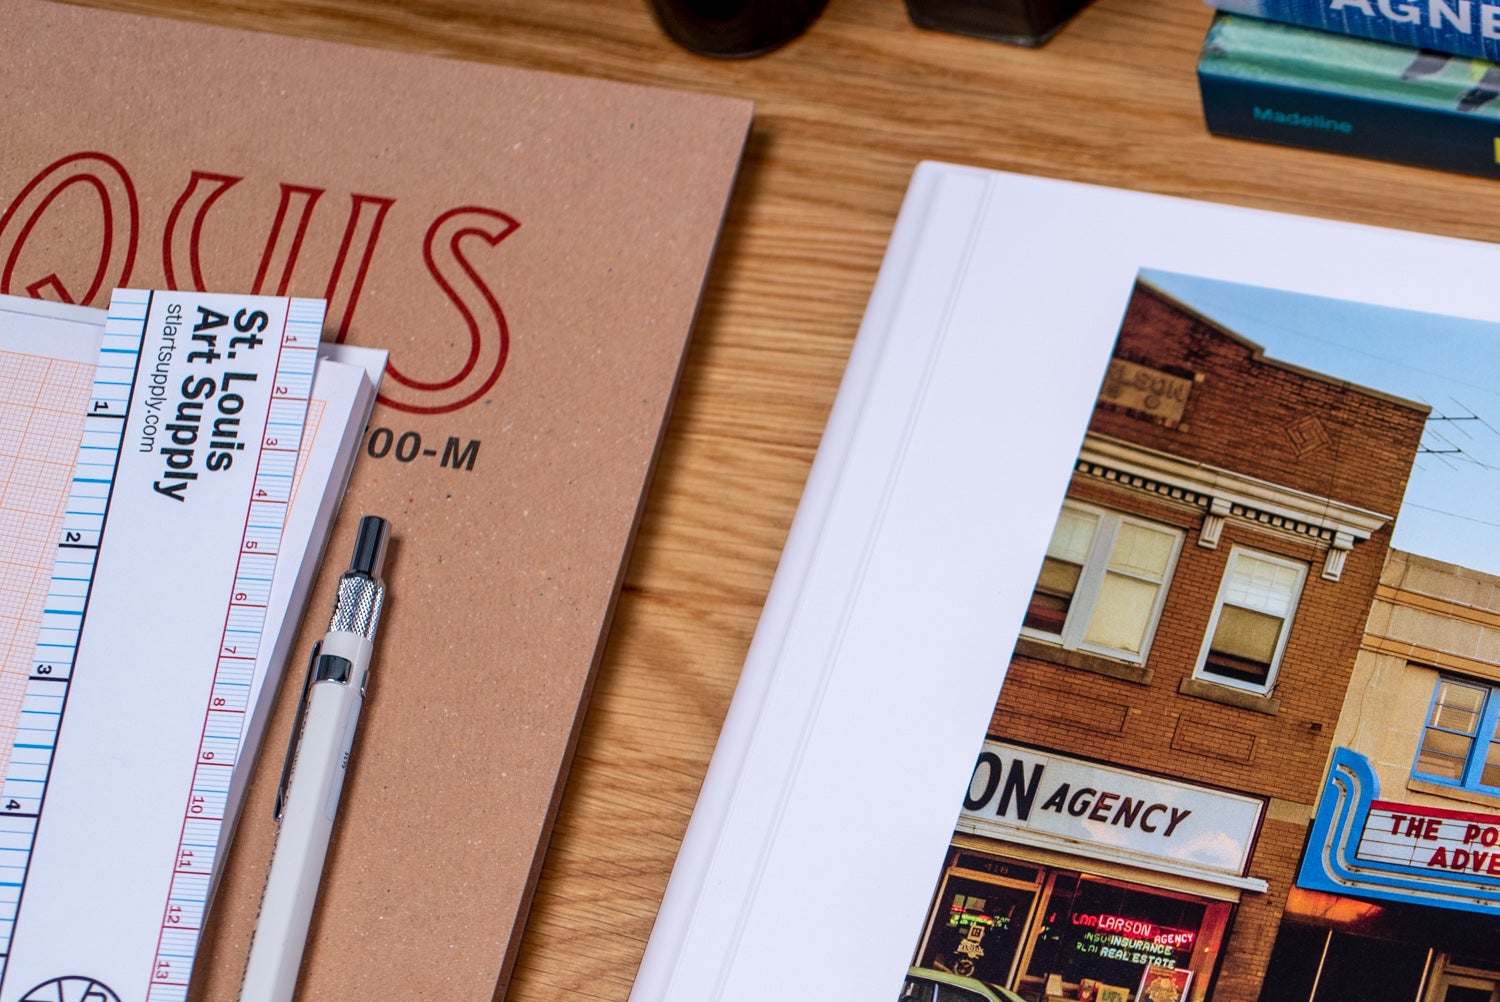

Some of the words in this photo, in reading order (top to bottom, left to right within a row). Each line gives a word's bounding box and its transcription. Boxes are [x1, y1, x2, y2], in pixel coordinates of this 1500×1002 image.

[1252, 105, 1353, 134] Madeline
[187, 305, 229, 364] Art
[227, 307, 269, 360] St.
[285, 335, 297, 344] 1
[139, 303, 182, 453] stlartsupply.com
[276, 386, 288, 395] 2
[94, 401, 109, 412] 1
[206, 371, 258, 472] Louis
[153, 374, 217, 503] Supply
[266, 438, 278, 446] 3
[364, 425, 481, 471] 00-M
[256, 489, 267, 497] 4
[66, 531, 82, 543] 2
[245, 540, 258, 549] 5
[235, 592, 247, 601] 6
[224, 646, 237, 654] 7
[37, 664, 52, 675] 3
[213, 698, 226, 707] 8
[202, 751, 214, 760] 9
[5, 799, 20, 811] 4
[191, 797, 205, 814] 10
[1041, 783, 1192, 838] AGENCY
[1391, 814, 1443, 841] THE
[179, 849, 194, 868] 11
[167, 905, 182, 924] 12
[1098, 914, 1152, 936] LARSON
[1153, 933, 1194, 945] AGENCY
[1110, 935, 1173, 956] INSURANCE
[1100, 946, 1130, 961] REAL
[1132, 954, 1176, 970] ESTATE
[156, 960, 171, 980] 13
